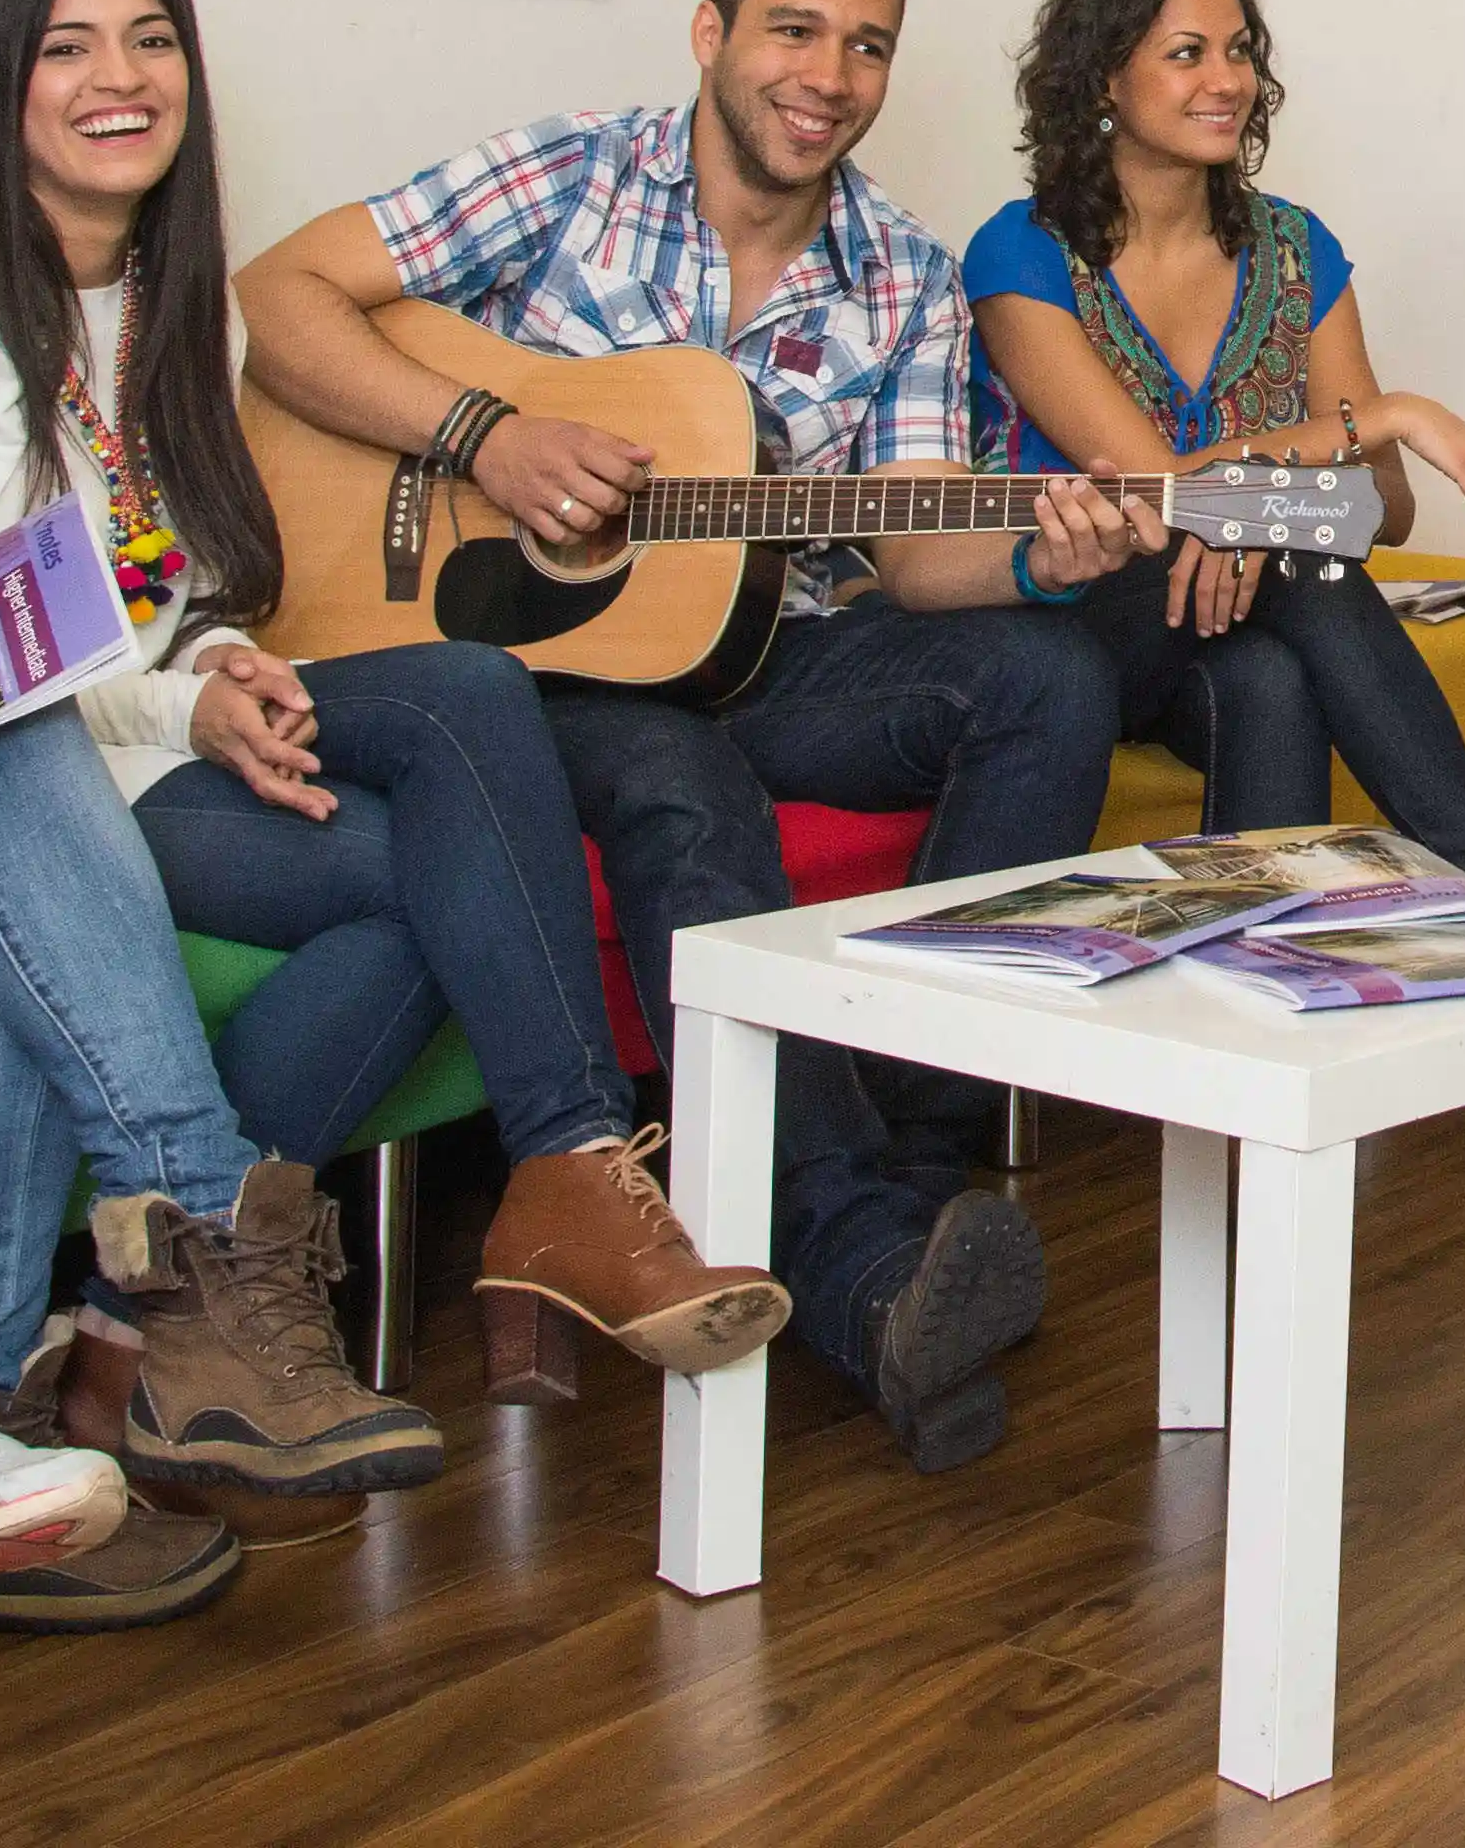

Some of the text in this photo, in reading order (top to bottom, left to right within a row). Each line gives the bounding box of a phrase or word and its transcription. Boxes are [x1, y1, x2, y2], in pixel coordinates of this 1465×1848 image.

[1261, 495, 1353, 519] Richwood
[2, 568, 28, 612] Higher
[13, 605, 48, 682] Intermediate
